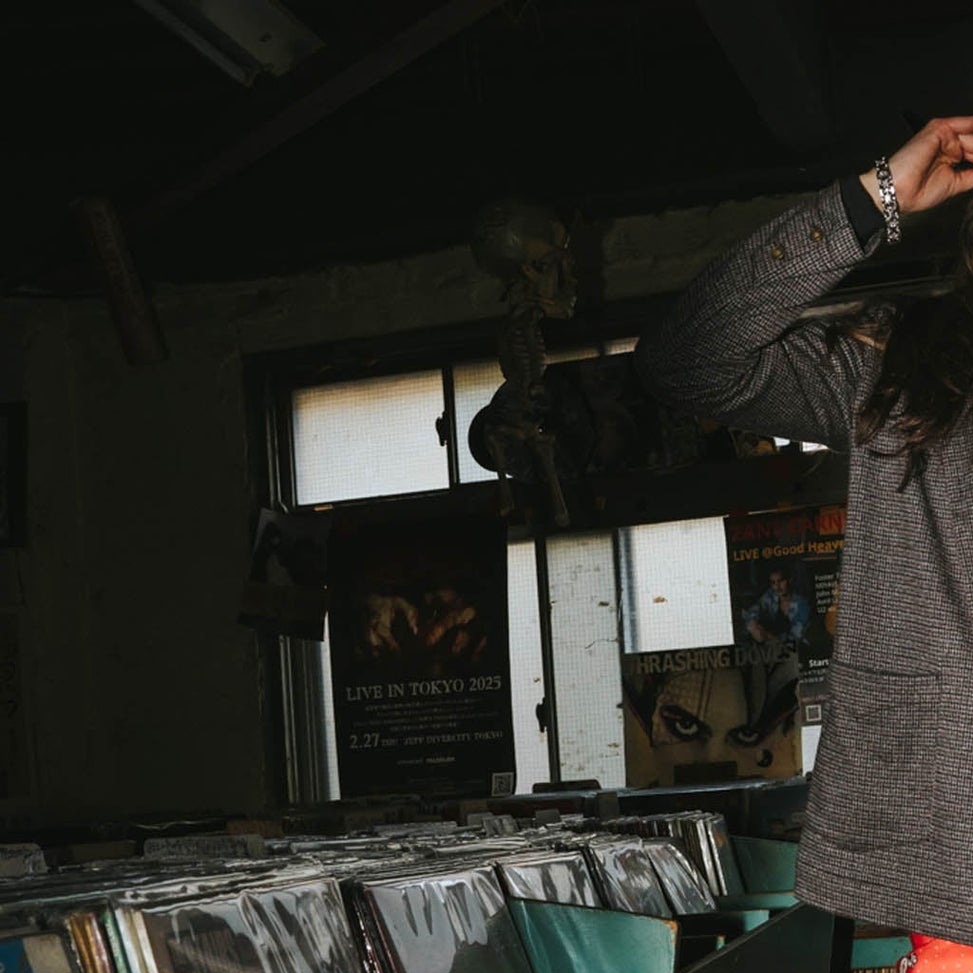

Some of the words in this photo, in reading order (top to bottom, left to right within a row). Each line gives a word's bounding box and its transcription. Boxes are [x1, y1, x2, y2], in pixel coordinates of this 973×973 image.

[733, 548, 759, 561] LIVE
[346, 685, 383, 701] LIVE
[387, 683, 405, 698] IN
[408, 678, 465, 696] TOKYO
[469, 675, 502, 692] 2025
[349, 733, 380, 749] 2.27
